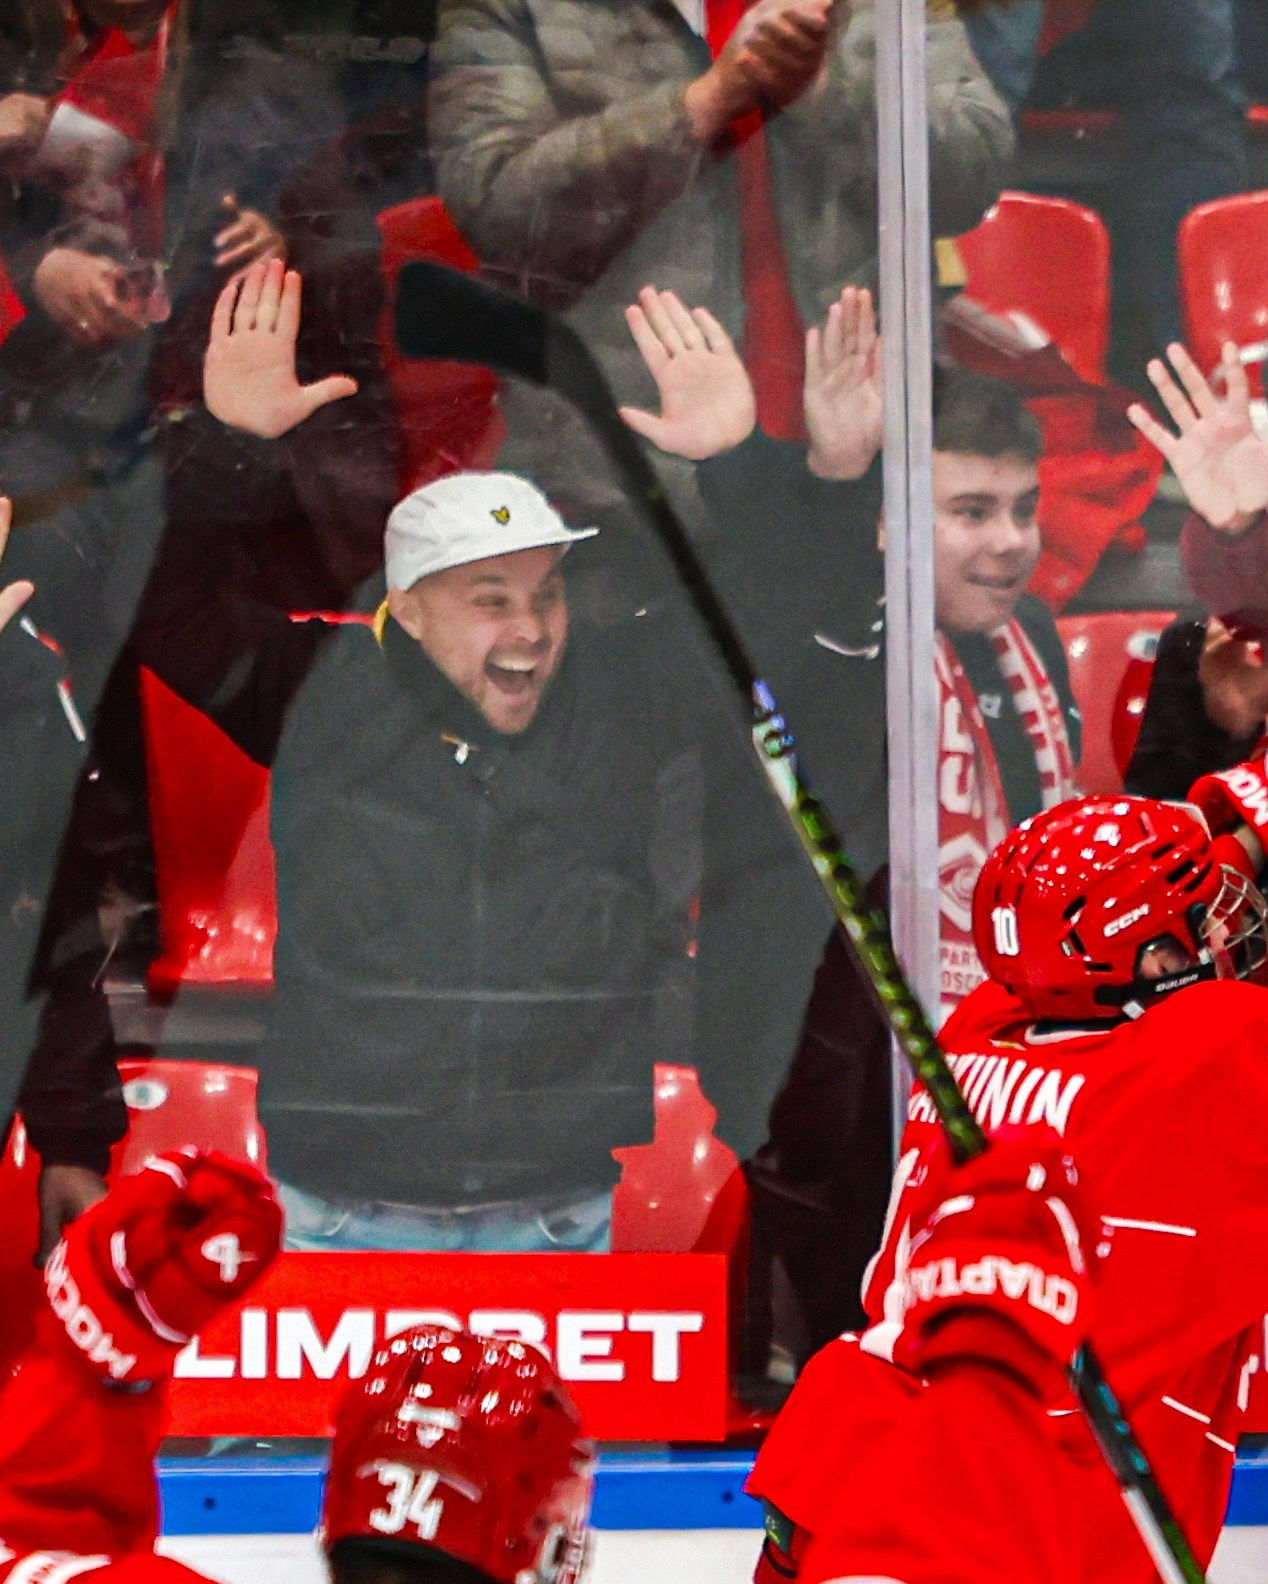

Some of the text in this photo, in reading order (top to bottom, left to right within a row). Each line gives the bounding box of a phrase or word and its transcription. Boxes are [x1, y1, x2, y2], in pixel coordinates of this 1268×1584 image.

[991, 906, 1020, 957] 10
[1102, 903, 1150, 938] CCM
[173, 1308, 704, 1382] LIMET
[368, 1459, 446, 1541] 34
